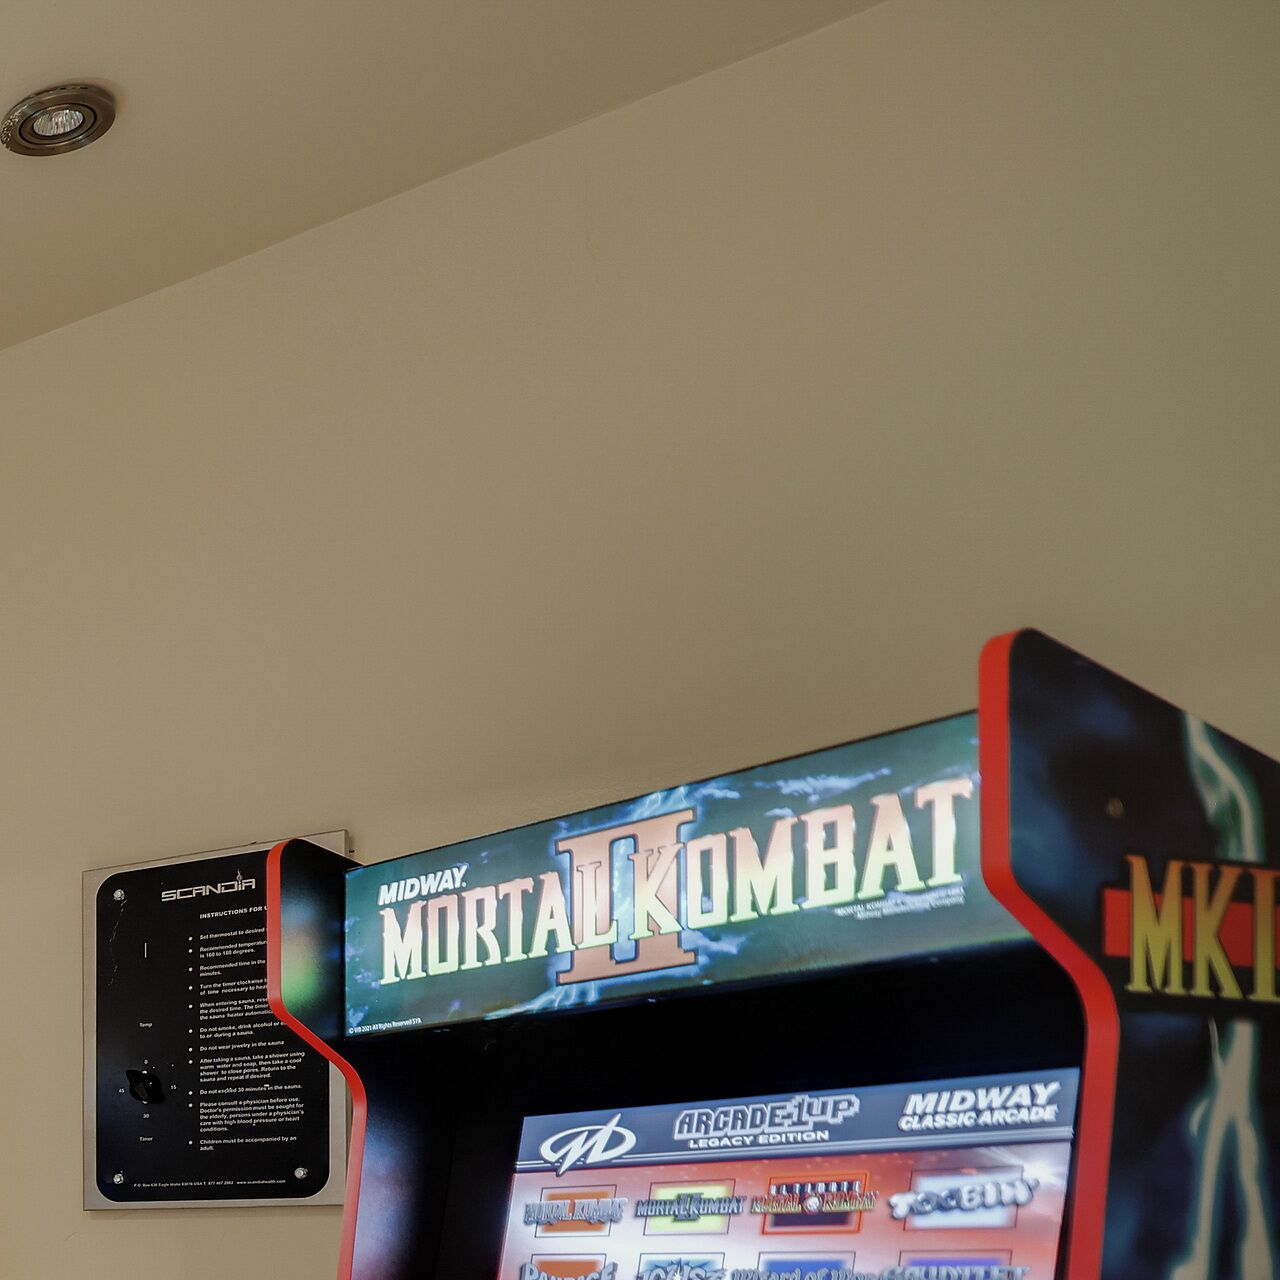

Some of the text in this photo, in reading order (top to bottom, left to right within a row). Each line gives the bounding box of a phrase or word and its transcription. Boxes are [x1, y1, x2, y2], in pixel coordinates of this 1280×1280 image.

[162, 874, 256, 902] SCANDIA
[379, 780, 974, 984] MORTAL KOMBAT
[379, 864, 466, 904] MIDWAY
[200, 908, 248, 919] INSTRUCTIONS
[210, 931, 238, 939] thermostat
[904, 1081, 1061, 1114] MIDWAY
[898, 1104, 1059, 1131] CLASSIC ARCADE
[689, 1130, 830, 1149] LEGACY EDITION
